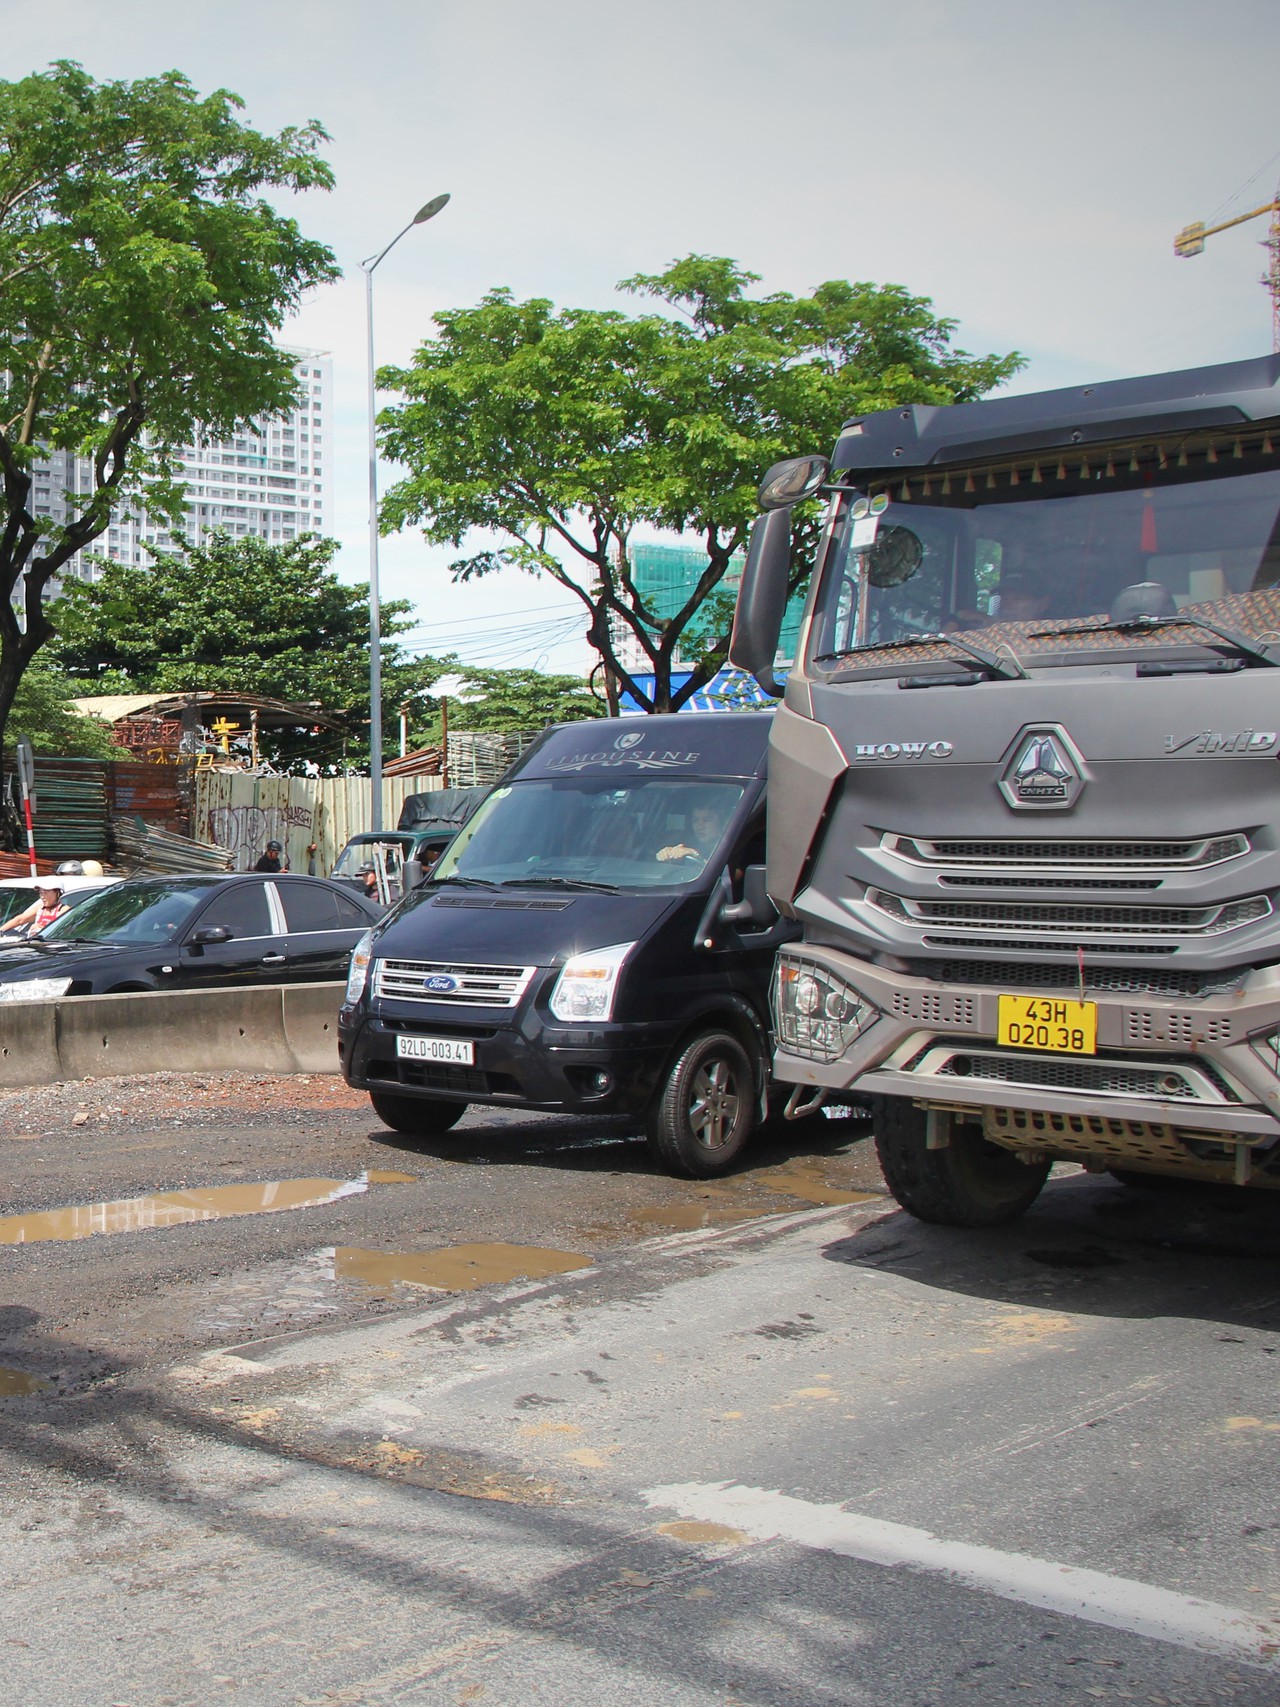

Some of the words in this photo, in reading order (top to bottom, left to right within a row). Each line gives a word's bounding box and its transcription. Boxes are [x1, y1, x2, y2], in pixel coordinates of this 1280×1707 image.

[545, 750, 701, 767] LIMOUSINE
[855, 741, 953, 761] HOWO
[1019, 787, 1063, 795] CNHTC
[428, 977, 451, 989] Ford
[1025, 1001, 1067, 1024] 43H
[1008, 1023, 1084, 1050] 020.38
[400, 1039, 469, 1062] 92LD-003.41
